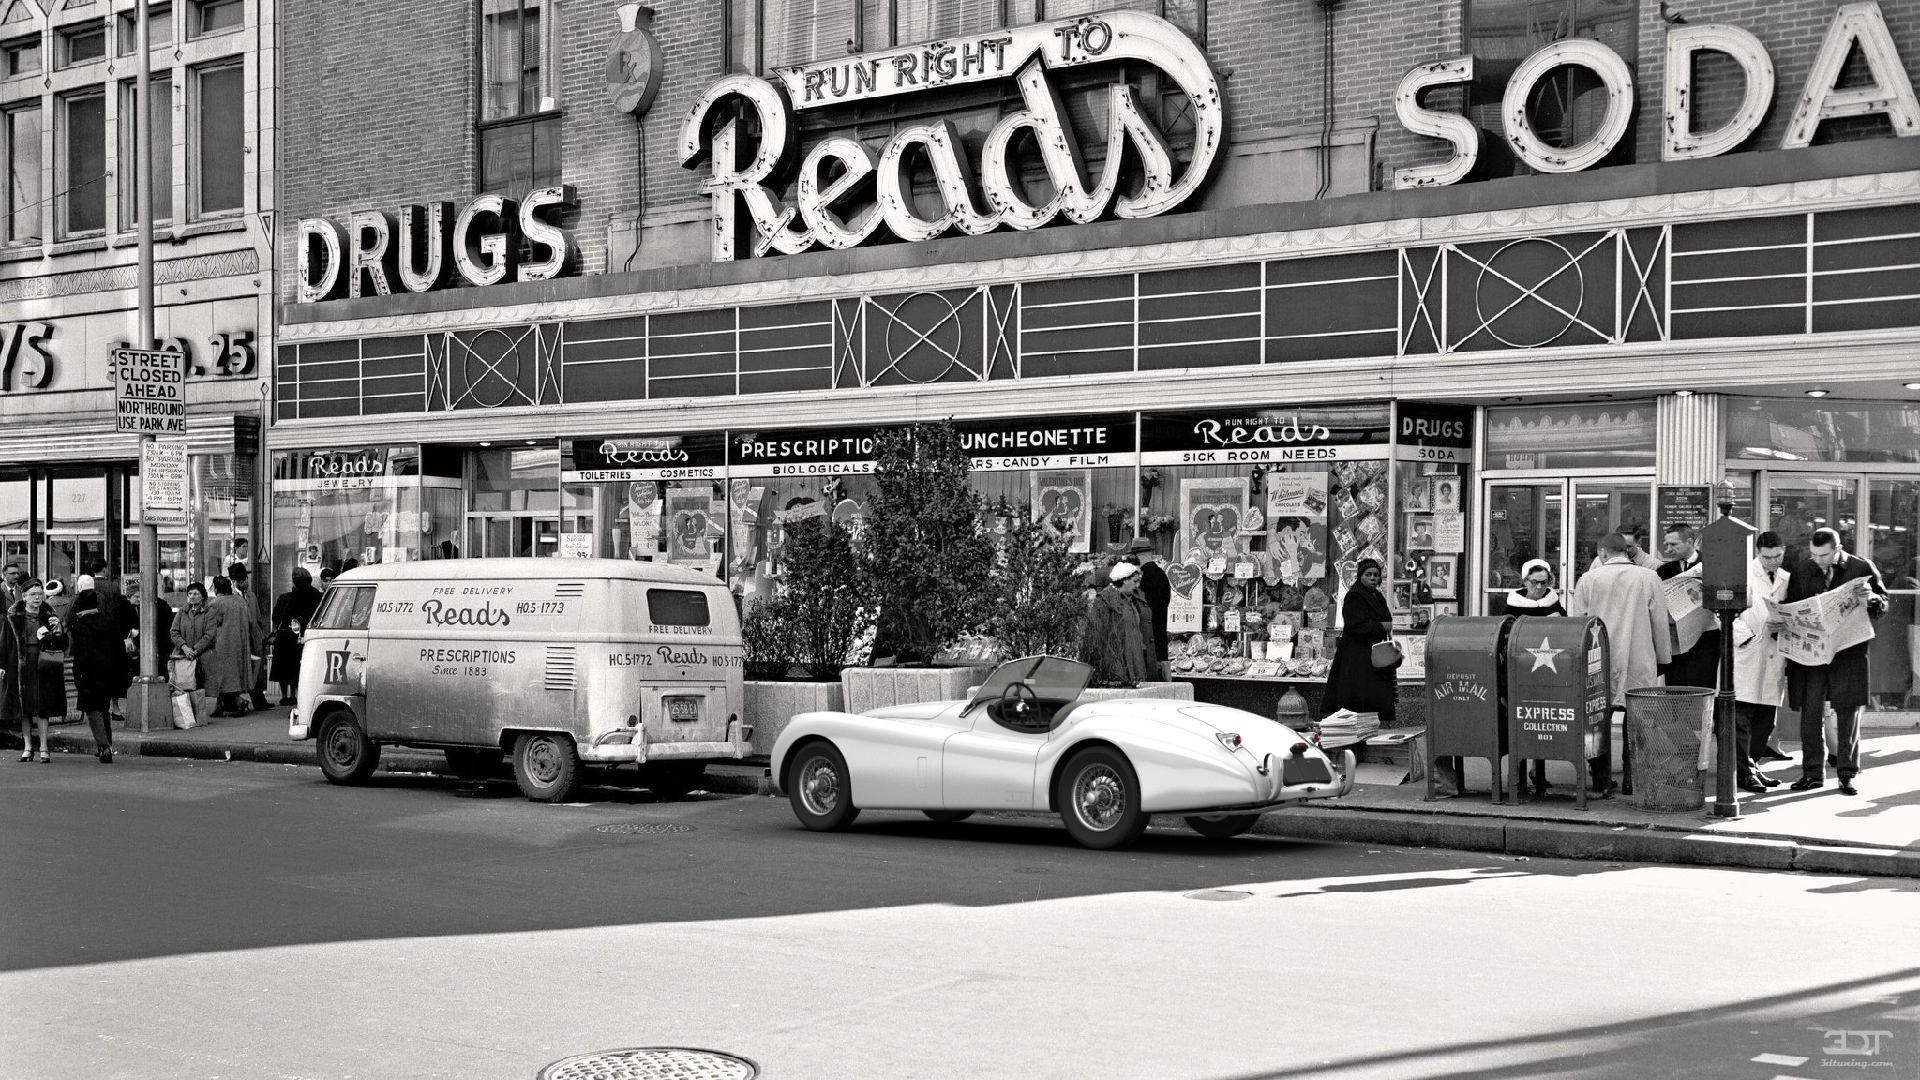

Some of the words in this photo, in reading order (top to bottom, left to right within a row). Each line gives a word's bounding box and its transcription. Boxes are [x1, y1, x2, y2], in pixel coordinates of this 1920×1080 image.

[804, 60, 877, 101] RUN
[894, 37, 1012, 88] RIGHT
[1054, 20, 1113, 62] TO
[1394, 3, 1920, 190] SODA
[299, 187, 568, 303] DRUGS
[118, 351, 181, 369] STREET
[120, 367, 181, 383] CLOSED
[125, 383, 177, 398] AHEAD
[118, 400, 184, 416] NORTHBOUND
[118, 416, 136, 430] USE
[140, 417, 164, 430] PARK
[167, 418, 184, 431] AVE
[1225, 418, 1242, 426] RUN
[1245, 417, 1269, 425] RIGHT
[1274, 416, 1285, 424] TO
[1403, 417, 1464, 439] DRUGS
[961, 427, 1107, 450] UNCHEONETTE
[1194, 417, 1330, 447] Read's
[598, 440, 689, 466] Read's
[741, 438, 873, 458] PRESCRIPTIO
[1183, 451, 1216, 462] SICK
[1227, 450, 1271, 461] ROOM
[1281, 448, 1337, 459] NEEDS
[1418, 448, 1456, 460] SODA
[772, 463, 870, 475] BIOLOGICALS
[968, 459, 993, 471] ARS
[1003, 456, 1050, 468] CANDY
[1069, 455, 1109, 465] FILM
[579, 471, 632, 481] TOILETRIES
[660, 468, 714, 478] COSMETICS
[432, 587, 456, 595] FREE
[462, 587, 514, 595] DELIVERY
[421, 599, 511, 627] Read's
[648, 625, 669, 634] FREE
[673, 625, 713, 636] DELIVERY
[419, 648, 516, 664] PRESCRIPTIONS
[432, 664, 458, 676] Since
[463, 665, 488, 677] 1883
[1446, 672, 1477, 680] DEPOSIT
[1434, 681, 1454, 701] AIR
[1516, 706, 1575, 721] EXPRESS
[1523, 722, 1568, 732] COLLECTION
